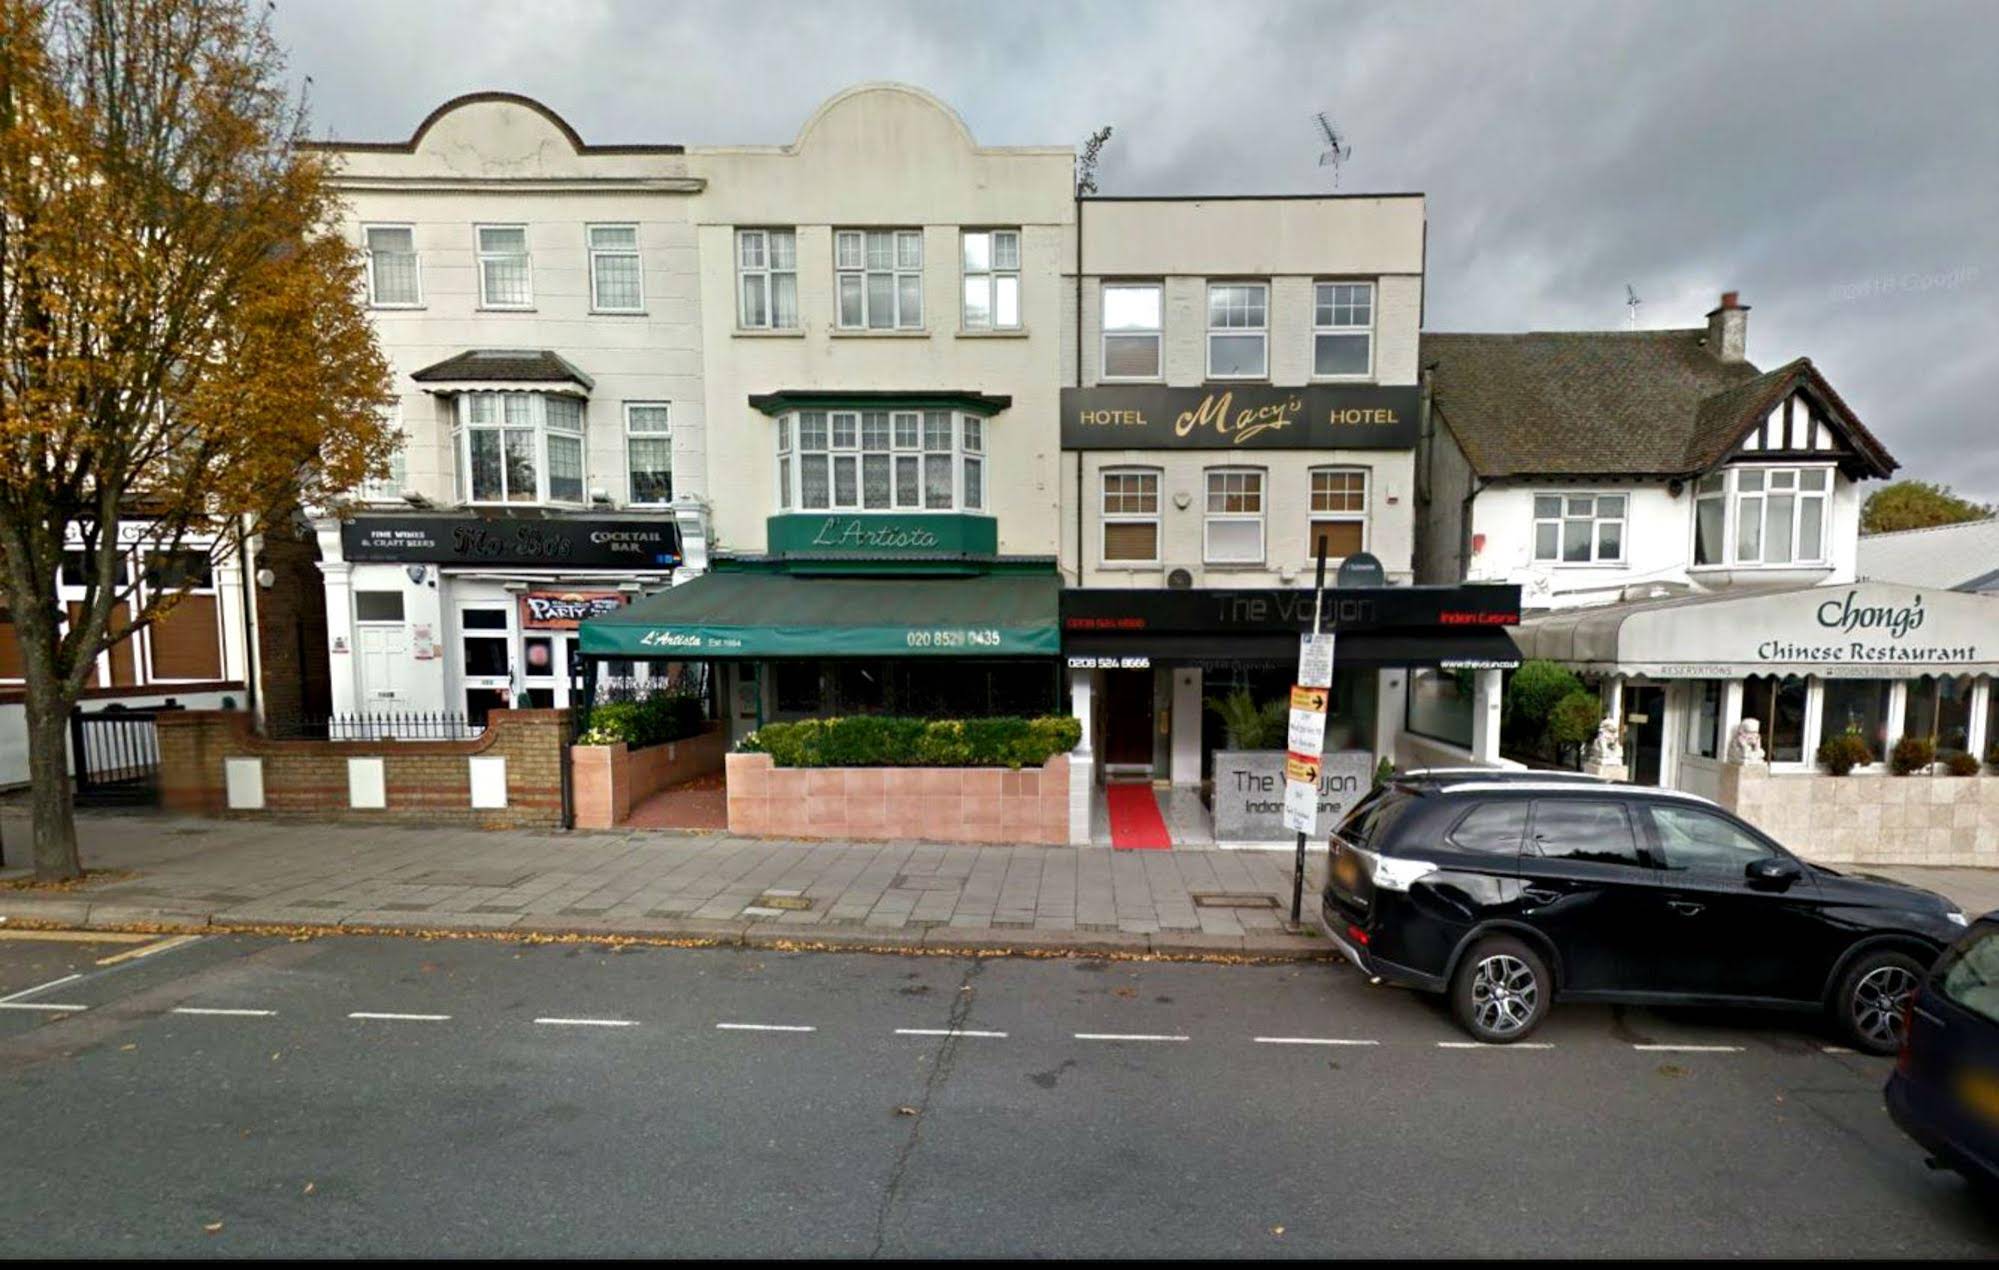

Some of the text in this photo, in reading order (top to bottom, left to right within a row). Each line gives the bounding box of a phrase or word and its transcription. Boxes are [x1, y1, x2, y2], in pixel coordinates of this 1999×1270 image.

[1080, 410, 1147, 425] HOTEL
[1175, 391, 1302, 444] Macy's
[1330, 408, 1399, 424] HOTEL
[590, 531, 661, 543] COCKTAIL
[812, 516, 940, 547] L'Artista
[611, 543, 642, 553] BAR
[527, 598, 586, 619] PARTY
[1211, 592, 1267, 622] The
[1817, 590, 1925, 639] Chong's
[641, 631, 702, 646] L'Artista
[907, 631, 931, 646] 020
[1758, 640, 1977, 660] Chinese Restaurant
[1233, 771, 1274, 792] The
